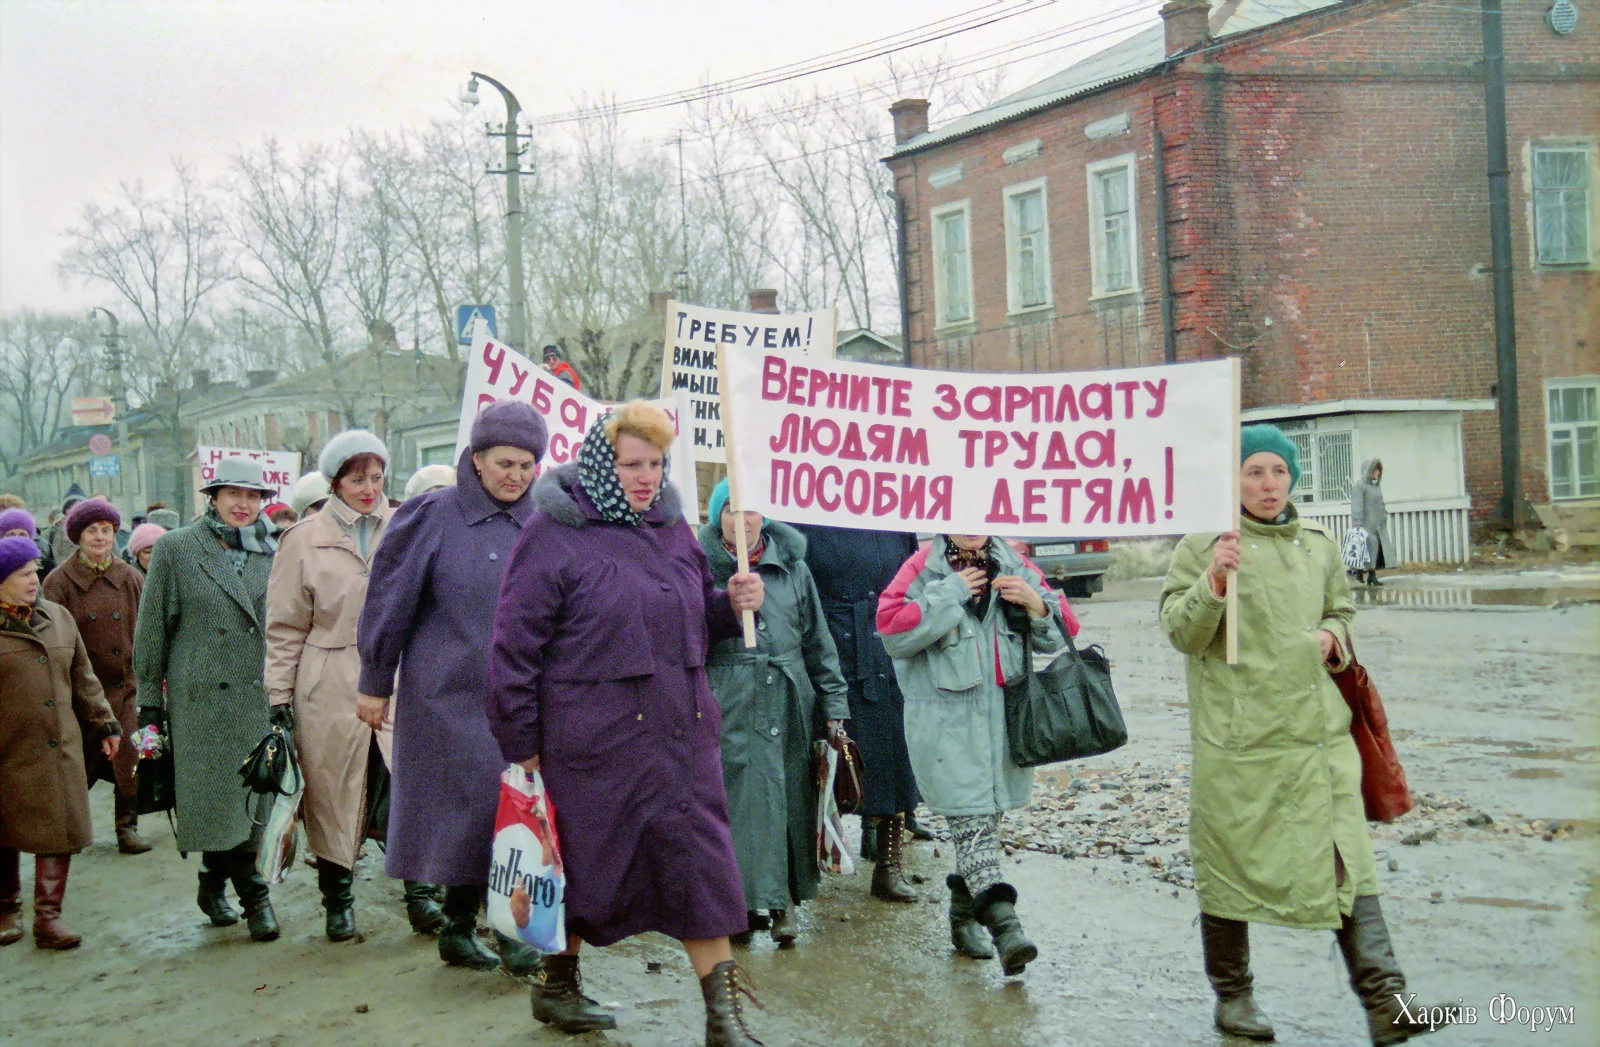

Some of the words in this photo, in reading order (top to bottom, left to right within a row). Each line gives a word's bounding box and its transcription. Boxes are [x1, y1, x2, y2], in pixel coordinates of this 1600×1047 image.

[677, 311, 813, 349] ТРЕБУЕМ!
[482, 341, 613, 435] ЧУБА
[761, 355, 913, 417] ВЕРНИТЕ
[932, 378, 1167, 423] ЗАРПЛАТУ
[769, 412, 929, 467] ЛЮДЯМ
[958, 428, 1132, 473] ТРУДА,
[770, 458, 953, 522] ПОСОБИЯ
[985, 446, 1174, 526] ДЕТЯМ!
[489, 847, 556, 909] arlboro
